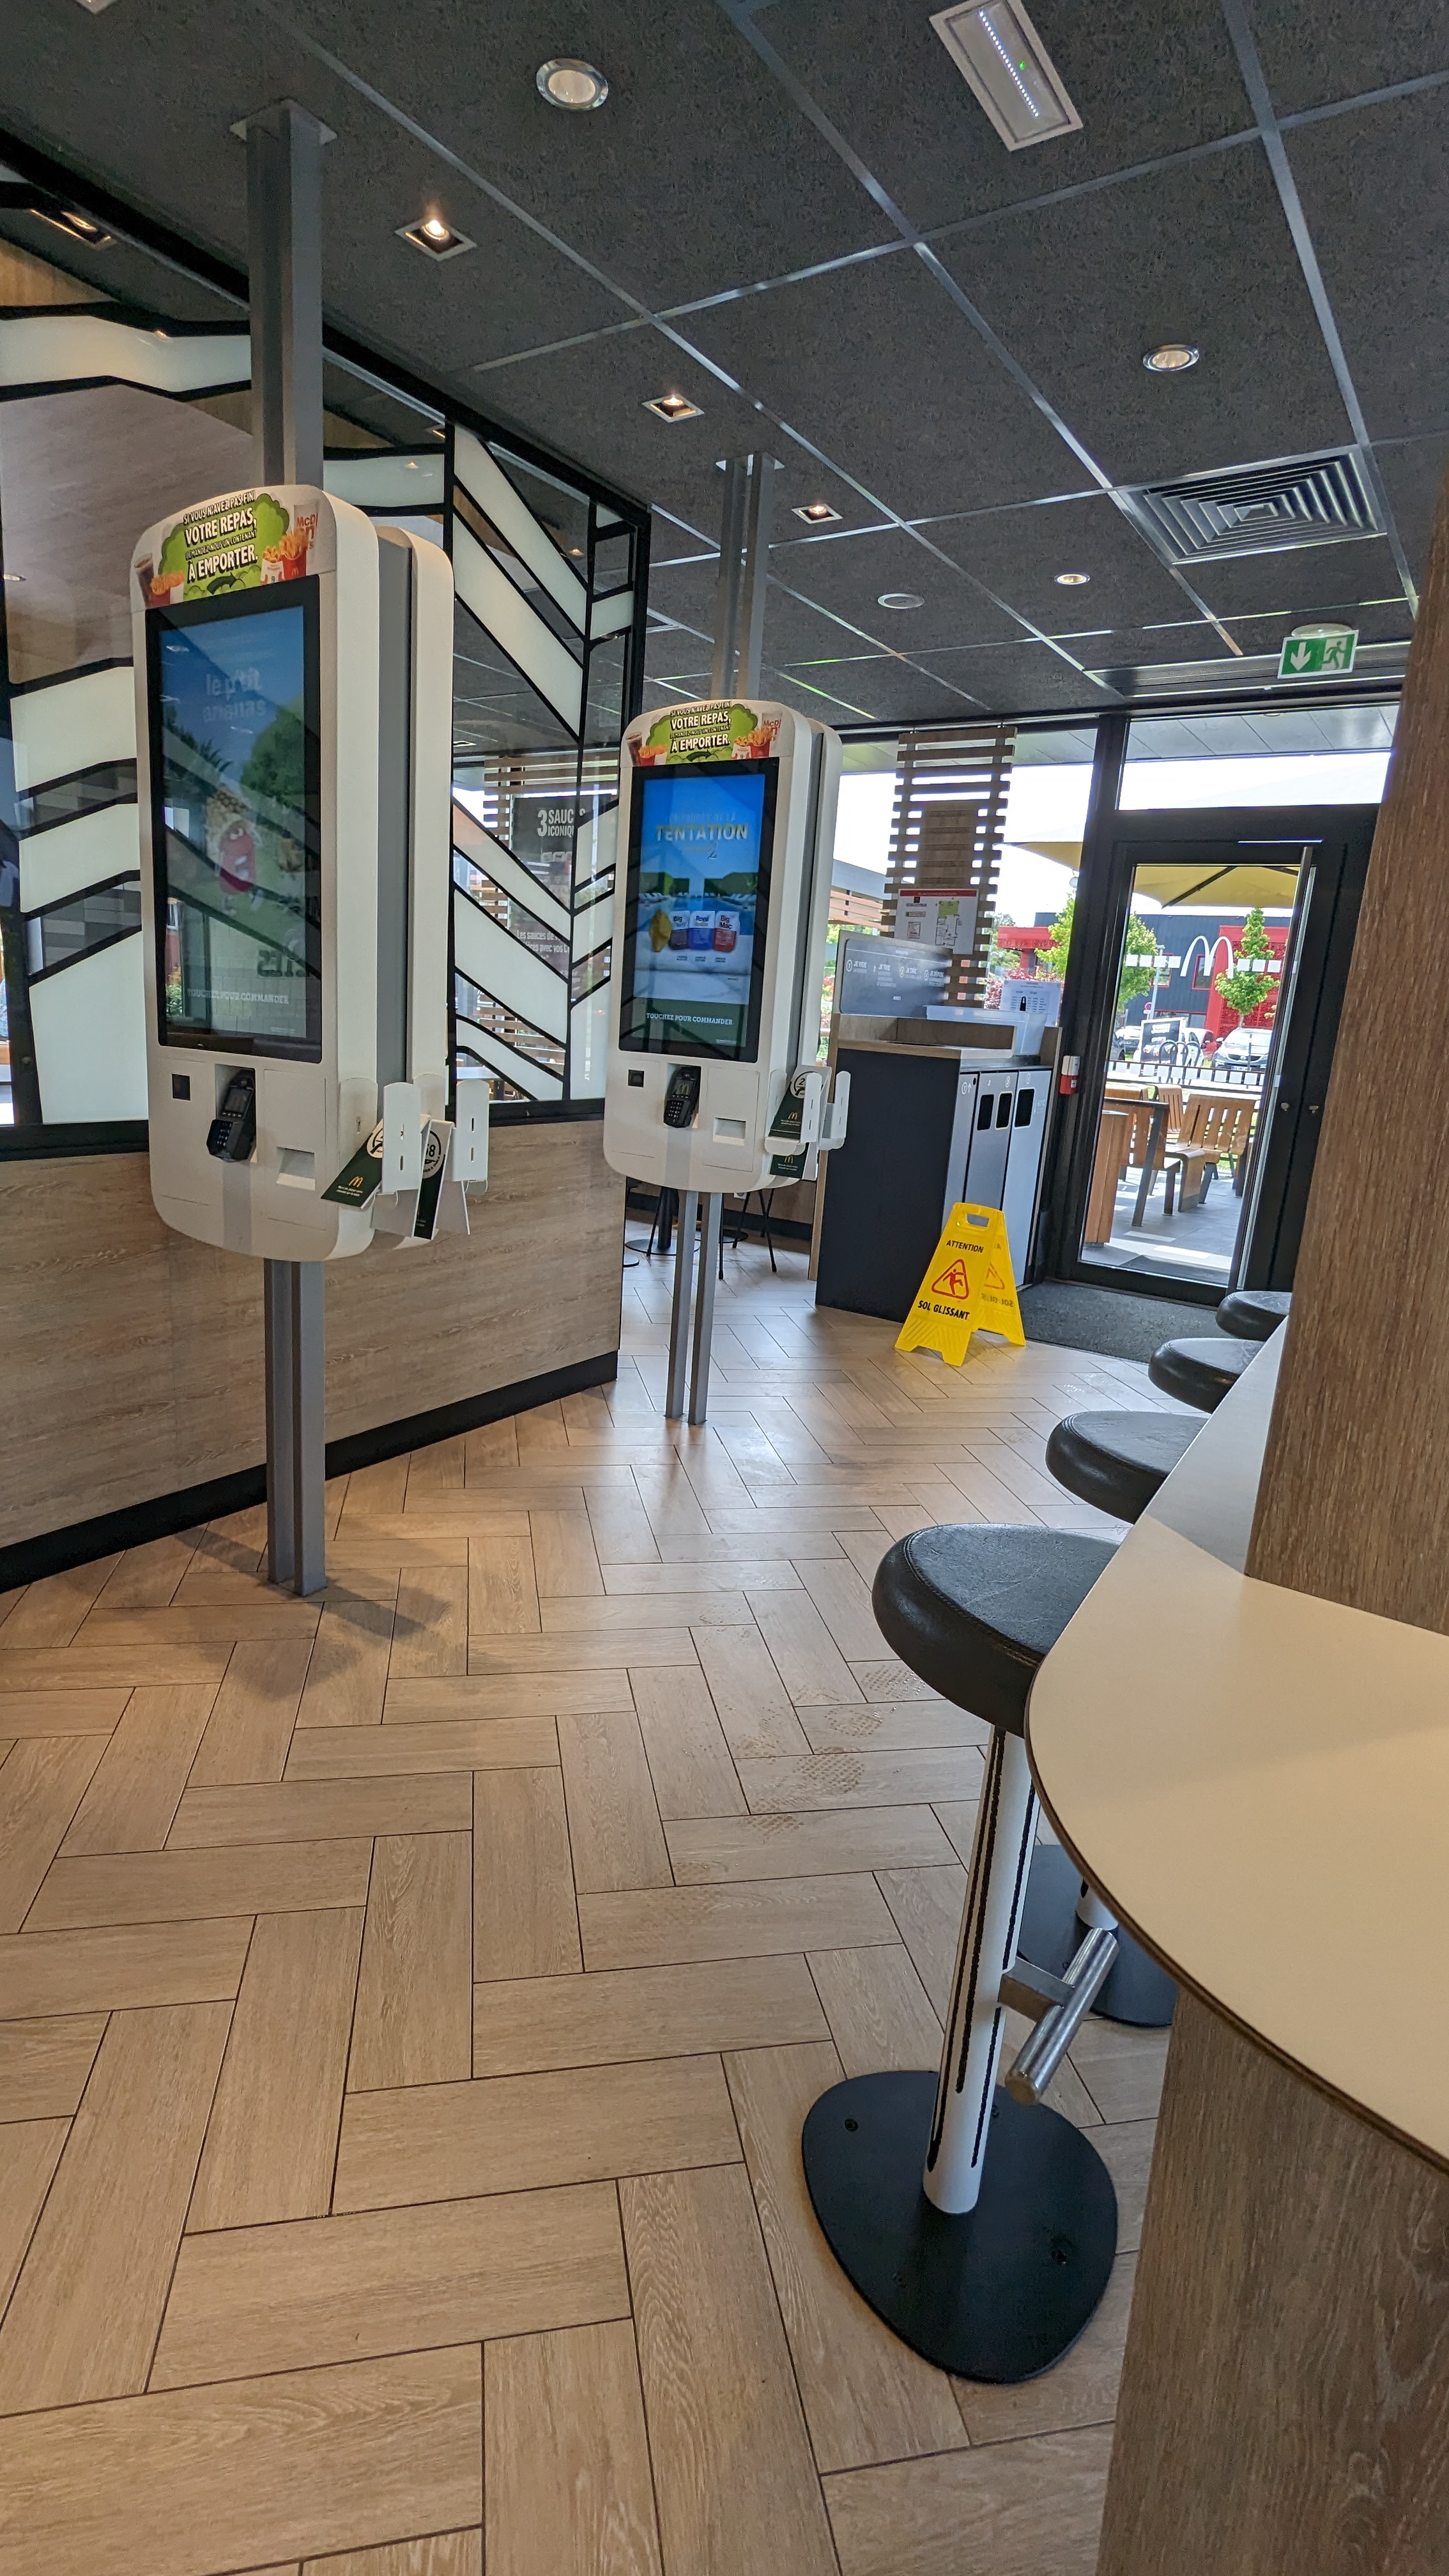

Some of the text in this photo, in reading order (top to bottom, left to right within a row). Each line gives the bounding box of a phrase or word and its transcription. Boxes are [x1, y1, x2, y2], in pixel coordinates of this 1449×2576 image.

[183, 514, 190, 525] SI
[191, 509, 206, 523] VOUS
[207, 499, 229, 516] N'AVEZ
[230, 494, 243, 509] PAS
[184, 507, 257, 547] VOTRE REPAS,
[230, 529, 257, 546] CONTENANT
[197, 544, 258, 580] EMPORTER.
[710, 702, 720, 710] PAS
[670, 711, 731, 730] VOTRE REPAS,
[678, 733, 731, 753] EMPORTER.
[537, 808, 586, 837] 3 SAUCS
[656, 823, 749, 841] TENTATION
[692, 1016, 733, 1025] COMMANDER
[946, 1239, 984, 1254] ATTENTION
[917, 1300, 970, 1321] SOL GLISSANT
